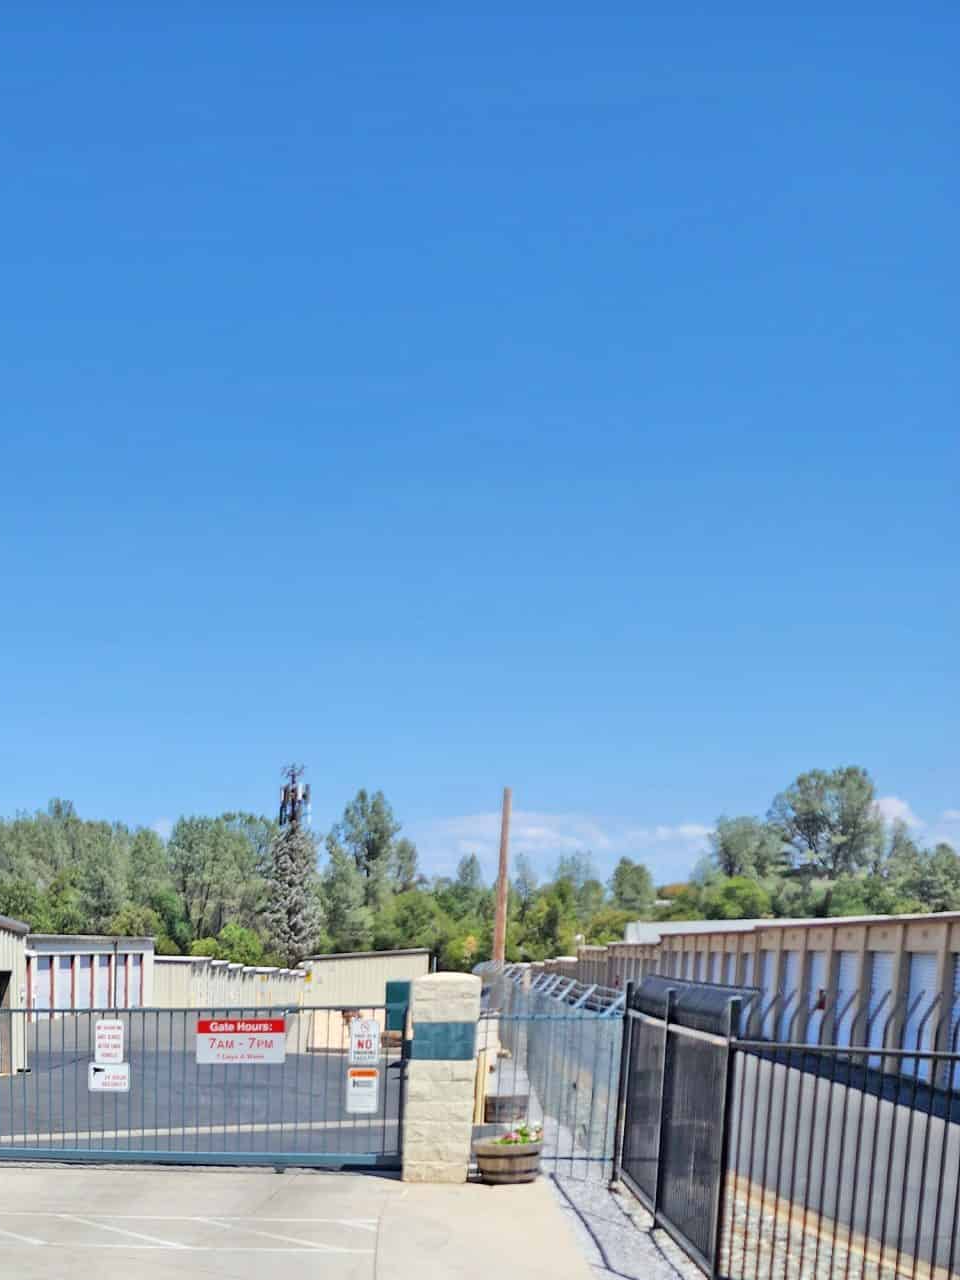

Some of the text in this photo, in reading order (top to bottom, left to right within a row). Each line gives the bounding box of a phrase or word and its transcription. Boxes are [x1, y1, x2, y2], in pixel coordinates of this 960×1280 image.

[209, 1022, 273, 1032] Gate Hours:
[208, 1038, 235, 1049] 7AM
[248, 1038, 274, 1049] 7PM
[357, 1039, 373, 1050] NO
